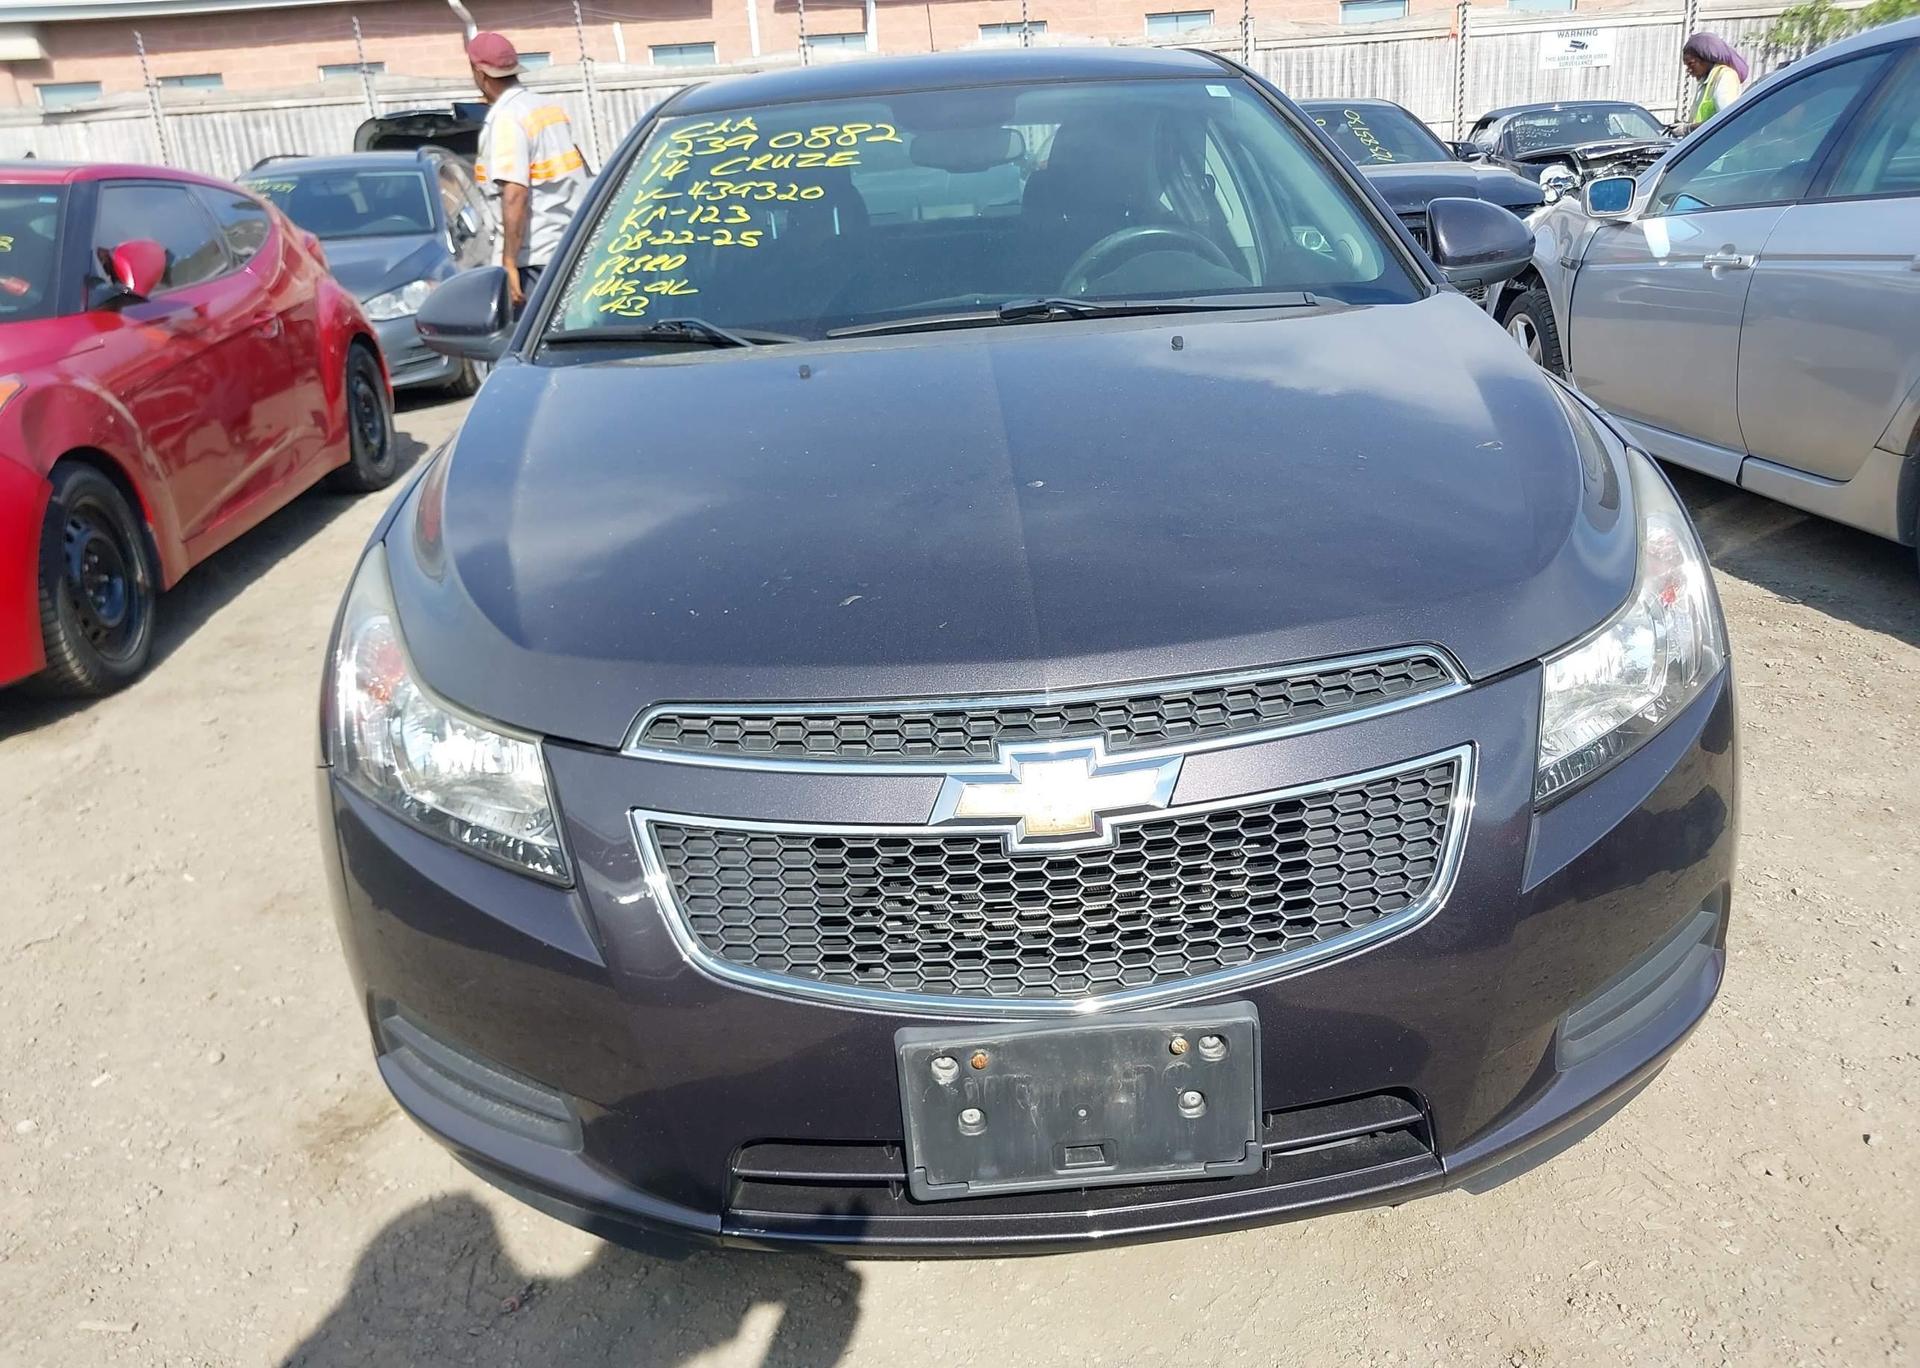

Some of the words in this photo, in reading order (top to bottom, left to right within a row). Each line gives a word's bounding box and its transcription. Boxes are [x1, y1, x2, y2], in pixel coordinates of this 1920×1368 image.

[1557, 28, 1599, 38] WARNING
[643, 159, 691, 186] 14
[709, 150, 862, 177] CRUZE
[607, 228, 764, 254] 08-22-25
